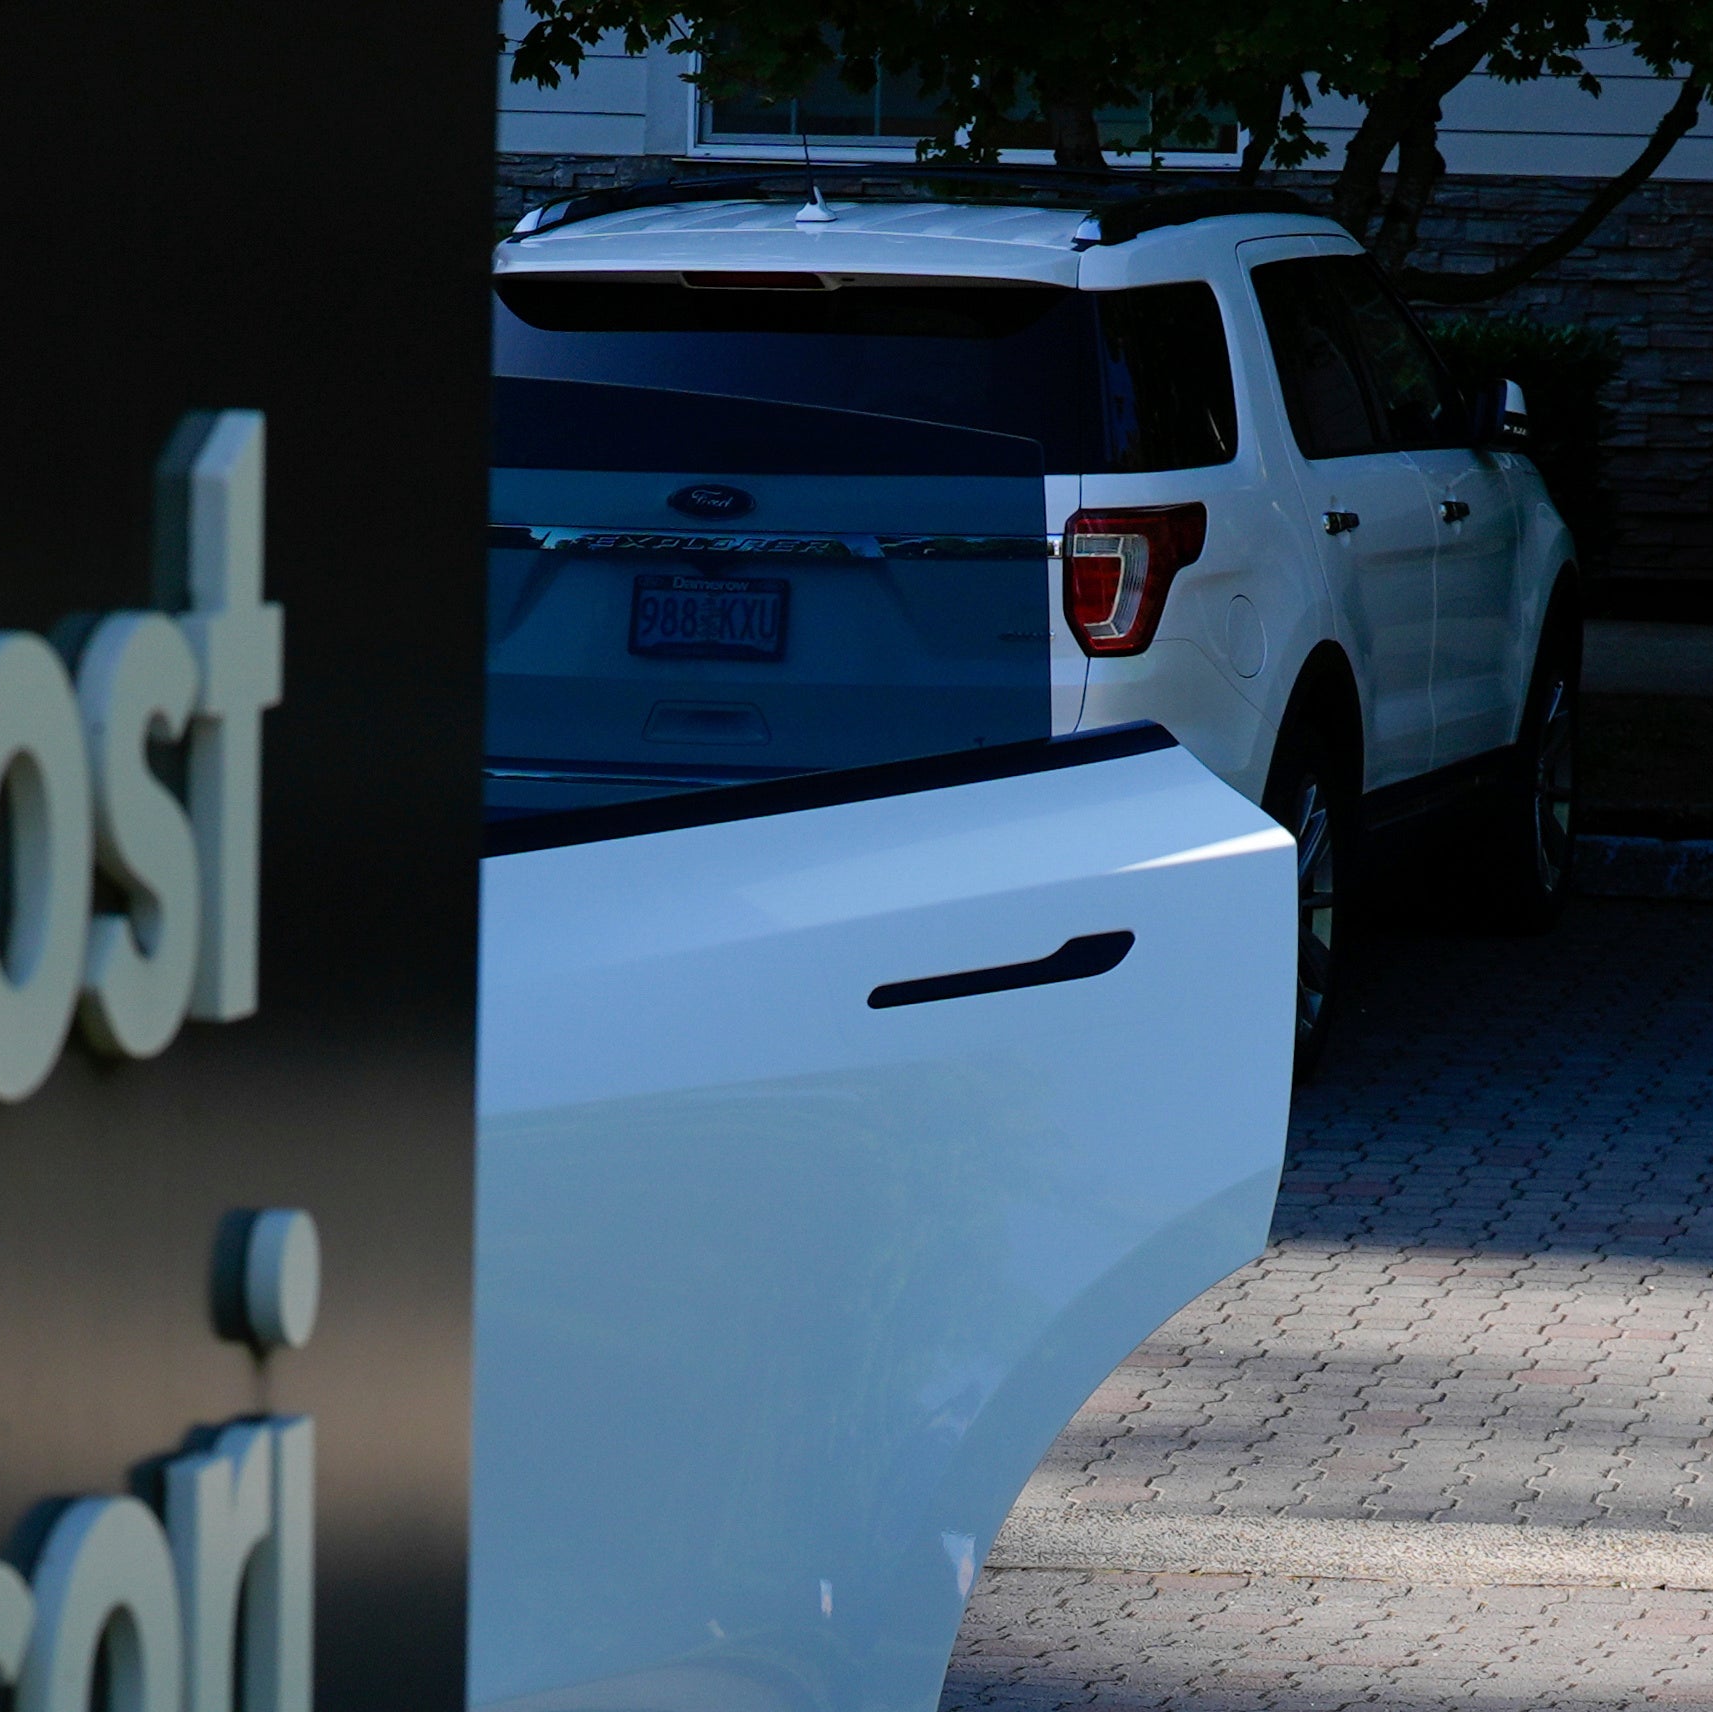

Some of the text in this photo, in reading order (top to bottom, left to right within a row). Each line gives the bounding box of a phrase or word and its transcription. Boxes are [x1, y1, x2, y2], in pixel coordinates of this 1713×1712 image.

[691, 489, 734, 508] Ford
[590, 535, 830, 553] EXPLORER
[672, 576, 750, 592] Damerow
[640, 596, 778, 640] 988 KXU
